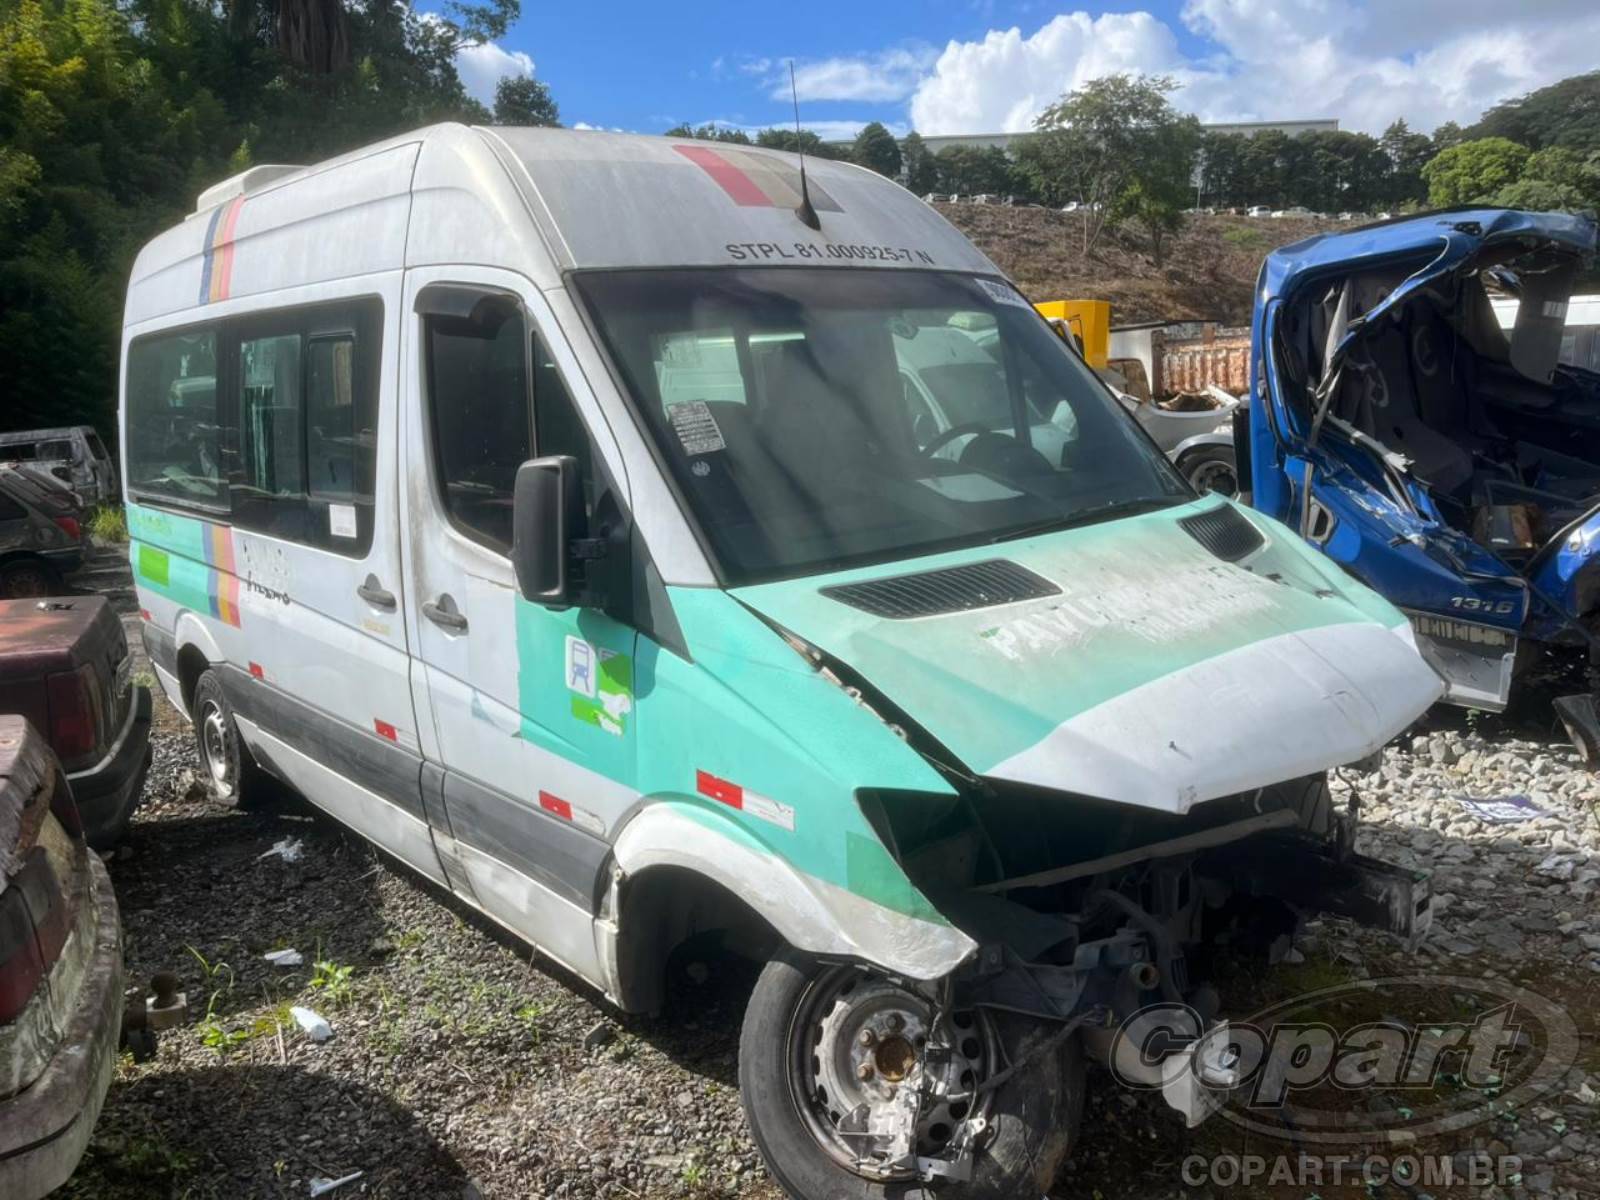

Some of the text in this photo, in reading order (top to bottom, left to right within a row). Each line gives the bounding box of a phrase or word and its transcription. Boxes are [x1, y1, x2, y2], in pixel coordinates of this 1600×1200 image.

[726, 243, 935, 265] STPL 81.000925-7 N
